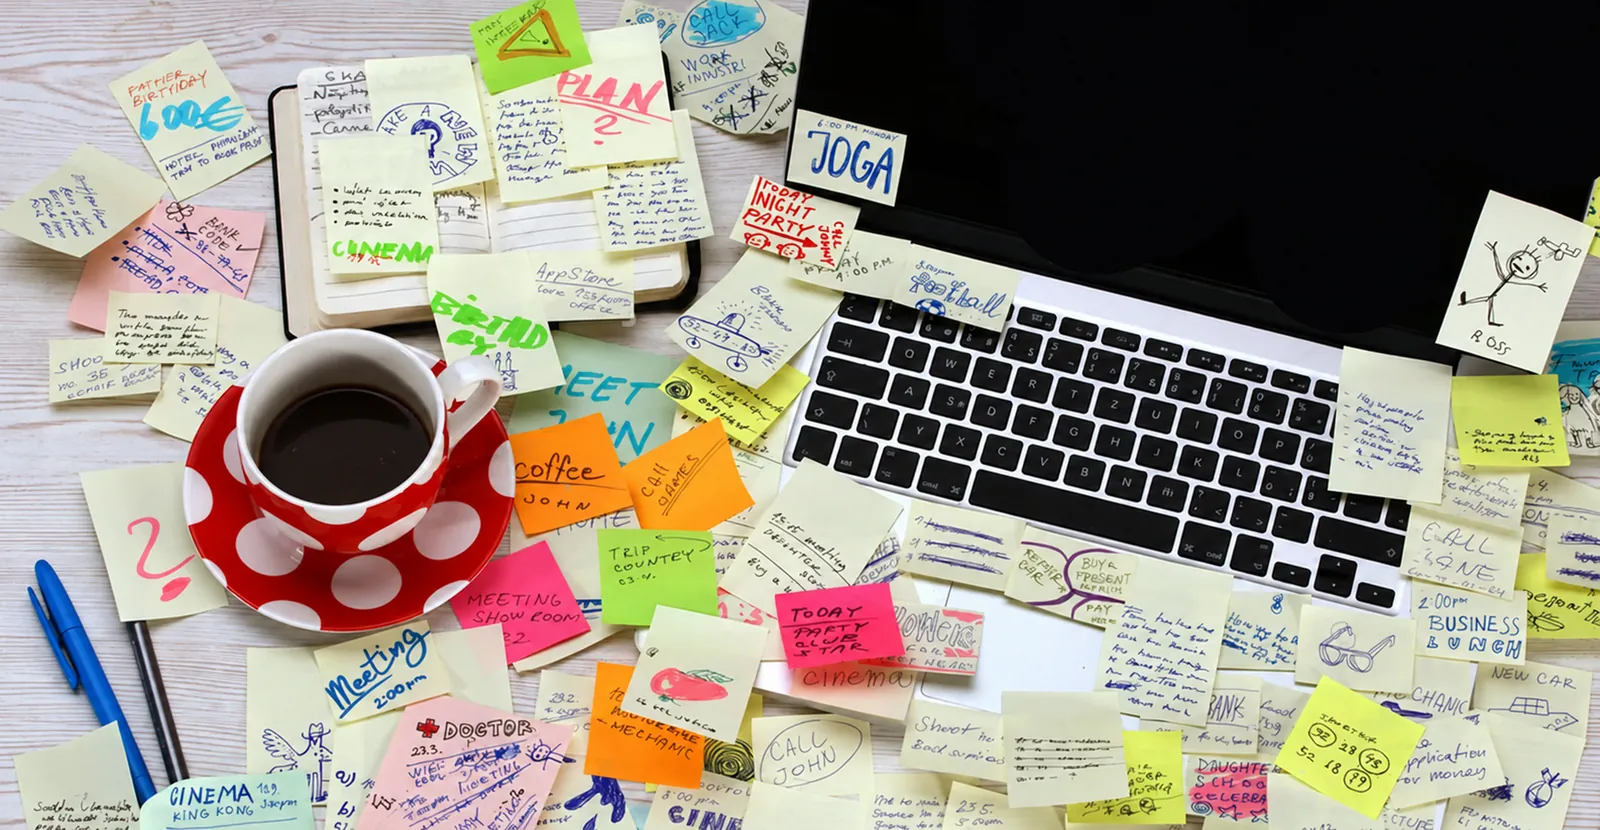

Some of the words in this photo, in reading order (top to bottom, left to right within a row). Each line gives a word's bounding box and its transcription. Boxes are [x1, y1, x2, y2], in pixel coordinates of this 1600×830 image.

[689, 3, 739, 28] CALL
[693, 15, 748, 45] JACK
[556, 70, 664, 113] PLAN
[817, 119, 842, 130] 6:00
[845, 123, 858, 132] PM
[862, 128, 900, 141] MONDAY
[807, 130, 894, 194] JOGA
[762, 179, 814, 204] TODAY
[755, 191, 816, 220] NIGHT
[742, 208, 815, 237] PARTY
[198, 225, 230, 251] CODE
[832, 221, 844, 249] CALL
[1470, 329, 1512, 356] ROSS
[515, 452, 605, 481] coffee
[524, 494, 591, 511] JOHN
[609, 546, 650, 561] TRIP
[1082, 557, 1106, 570] BUY
[467, 593, 562, 607] MEETING
[1086, 604, 1112, 615] PAY
[472, 611, 524, 624] SHOW
[530, 613, 580, 624] ROOM
[791, 605, 863, 624] TODAY
[1428, 615, 1520, 635] BUSINESS
[793, 622, 869, 639] PARTY
[1427, 636, 1522, 659] LUNCH
[325, 627, 431, 711] Meeting
[803, 667, 914, 689] cinema
[1491, 666, 1529, 684] NEW
[1537, 672, 1577, 690] CAR
[443, 718, 534, 740] DOCTOR
[611, 722, 694, 760] MECHANIC
[770, 731, 828, 762] CALL
[1339, 743, 1357, 755] 28
[773, 745, 836, 785] JOHN
[1296, 746, 1315, 763] 52
[1403, 743, 1487, 775] pplication
[1195, 776, 1267, 790] SCHOO
[170, 783, 254, 807] CINEMA
[1193, 792, 1267, 804] CELEBRA
[173, 809, 209, 822] KING
[216, 805, 254, 816] KONG
